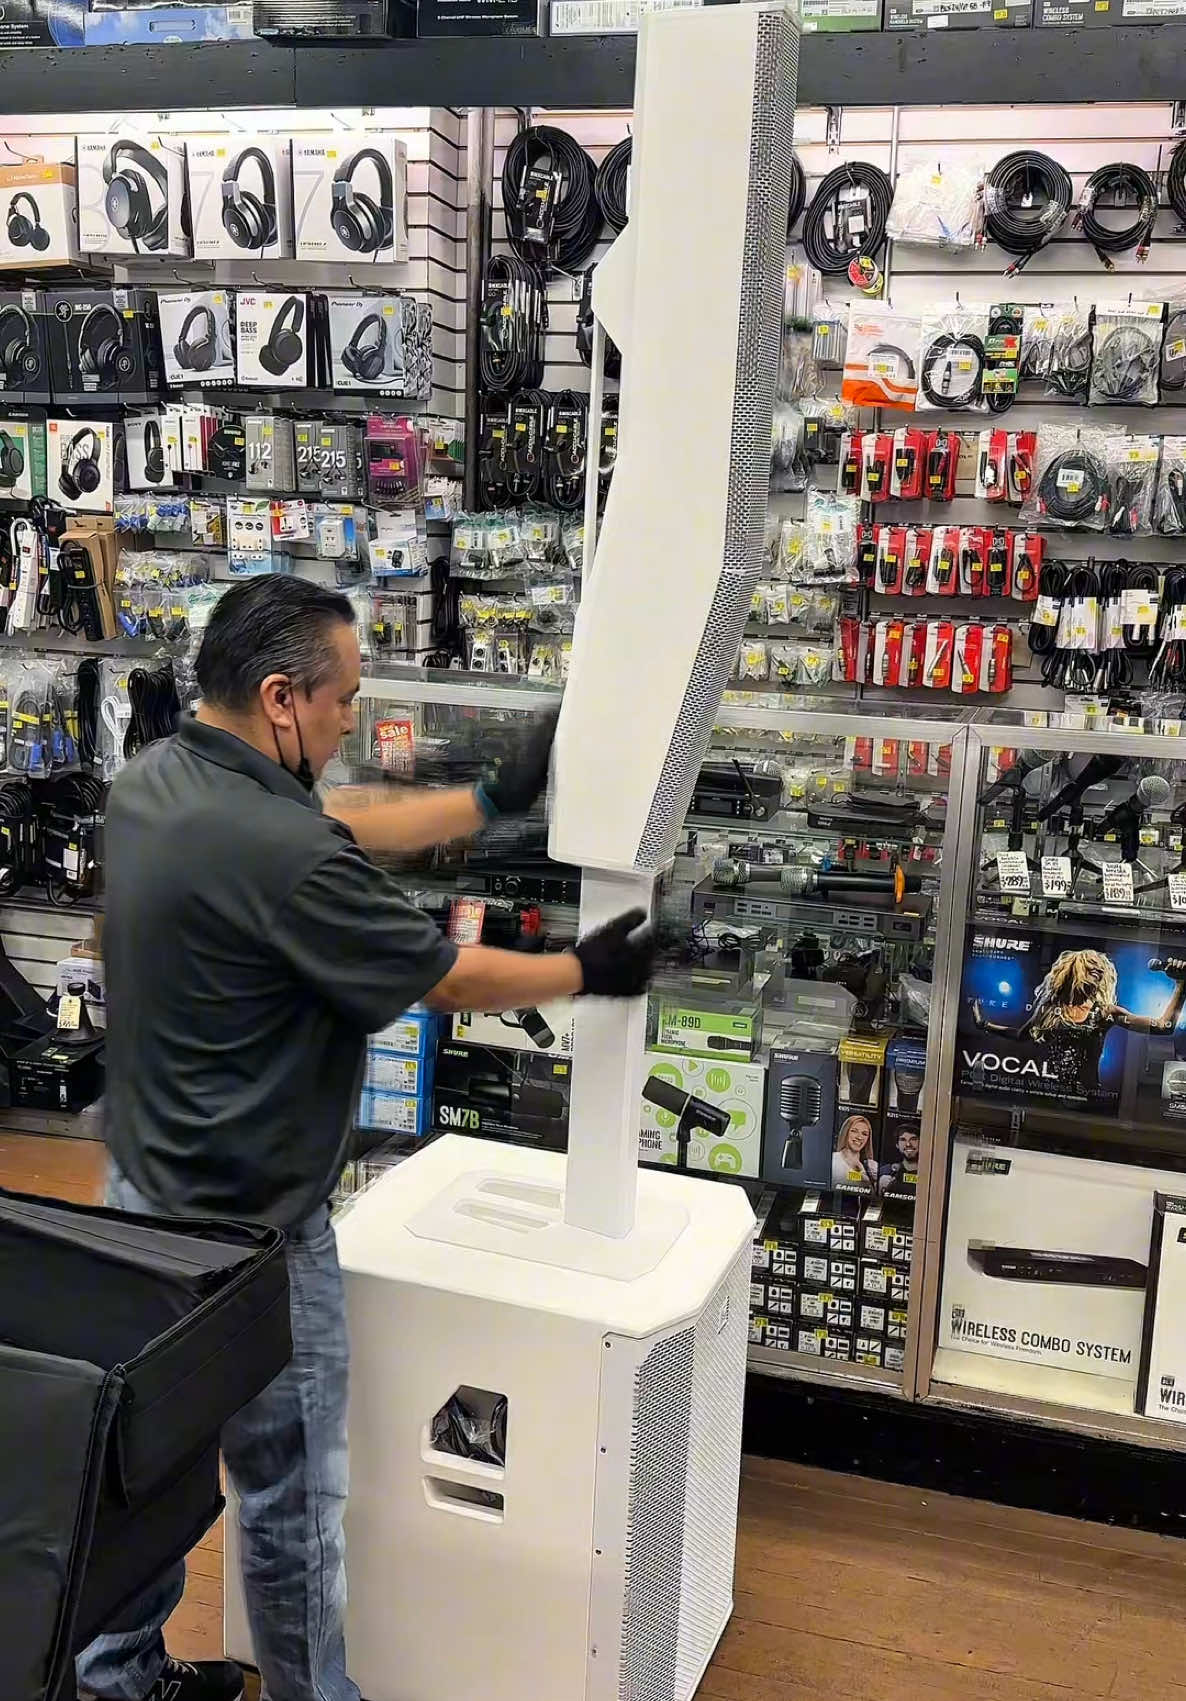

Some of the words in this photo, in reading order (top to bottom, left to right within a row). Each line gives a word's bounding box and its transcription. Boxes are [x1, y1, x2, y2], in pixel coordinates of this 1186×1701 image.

[240, 298, 256, 306] JVC
[248, 442, 272, 460] 112
[297, 446, 320, 462] 215
[321, 450, 347, 468] 215
[379, 725, 408, 738] sale
[1045, 880, 1067, 892] $199
[973, 935, 1031, 951] SHURE
[664, 1014, 701, 1029] M-89D
[442, 1048, 469, 1058] SHURE
[773, 1053, 799, 1061] SHURE
[841, 1050, 882, 1060] VERSATILITY
[962, 1050, 1059, 1079] VOCAL
[991, 1073, 1024, 1086] Digital
[1028, 1078, 1073, 1092] Wireless
[1076, 1085, 1119, 1099] System
[439, 1105, 480, 1129] SM7B
[835, 1183, 871, 1194] SAMSON
[951, 1318, 1017, 1342] WIRELESS
[1021, 1331, 1071, 1353] COMBO
[1076, 1341, 1132, 1364] SYSTEM
[1160, 1387, 1186, 1406] WIR
